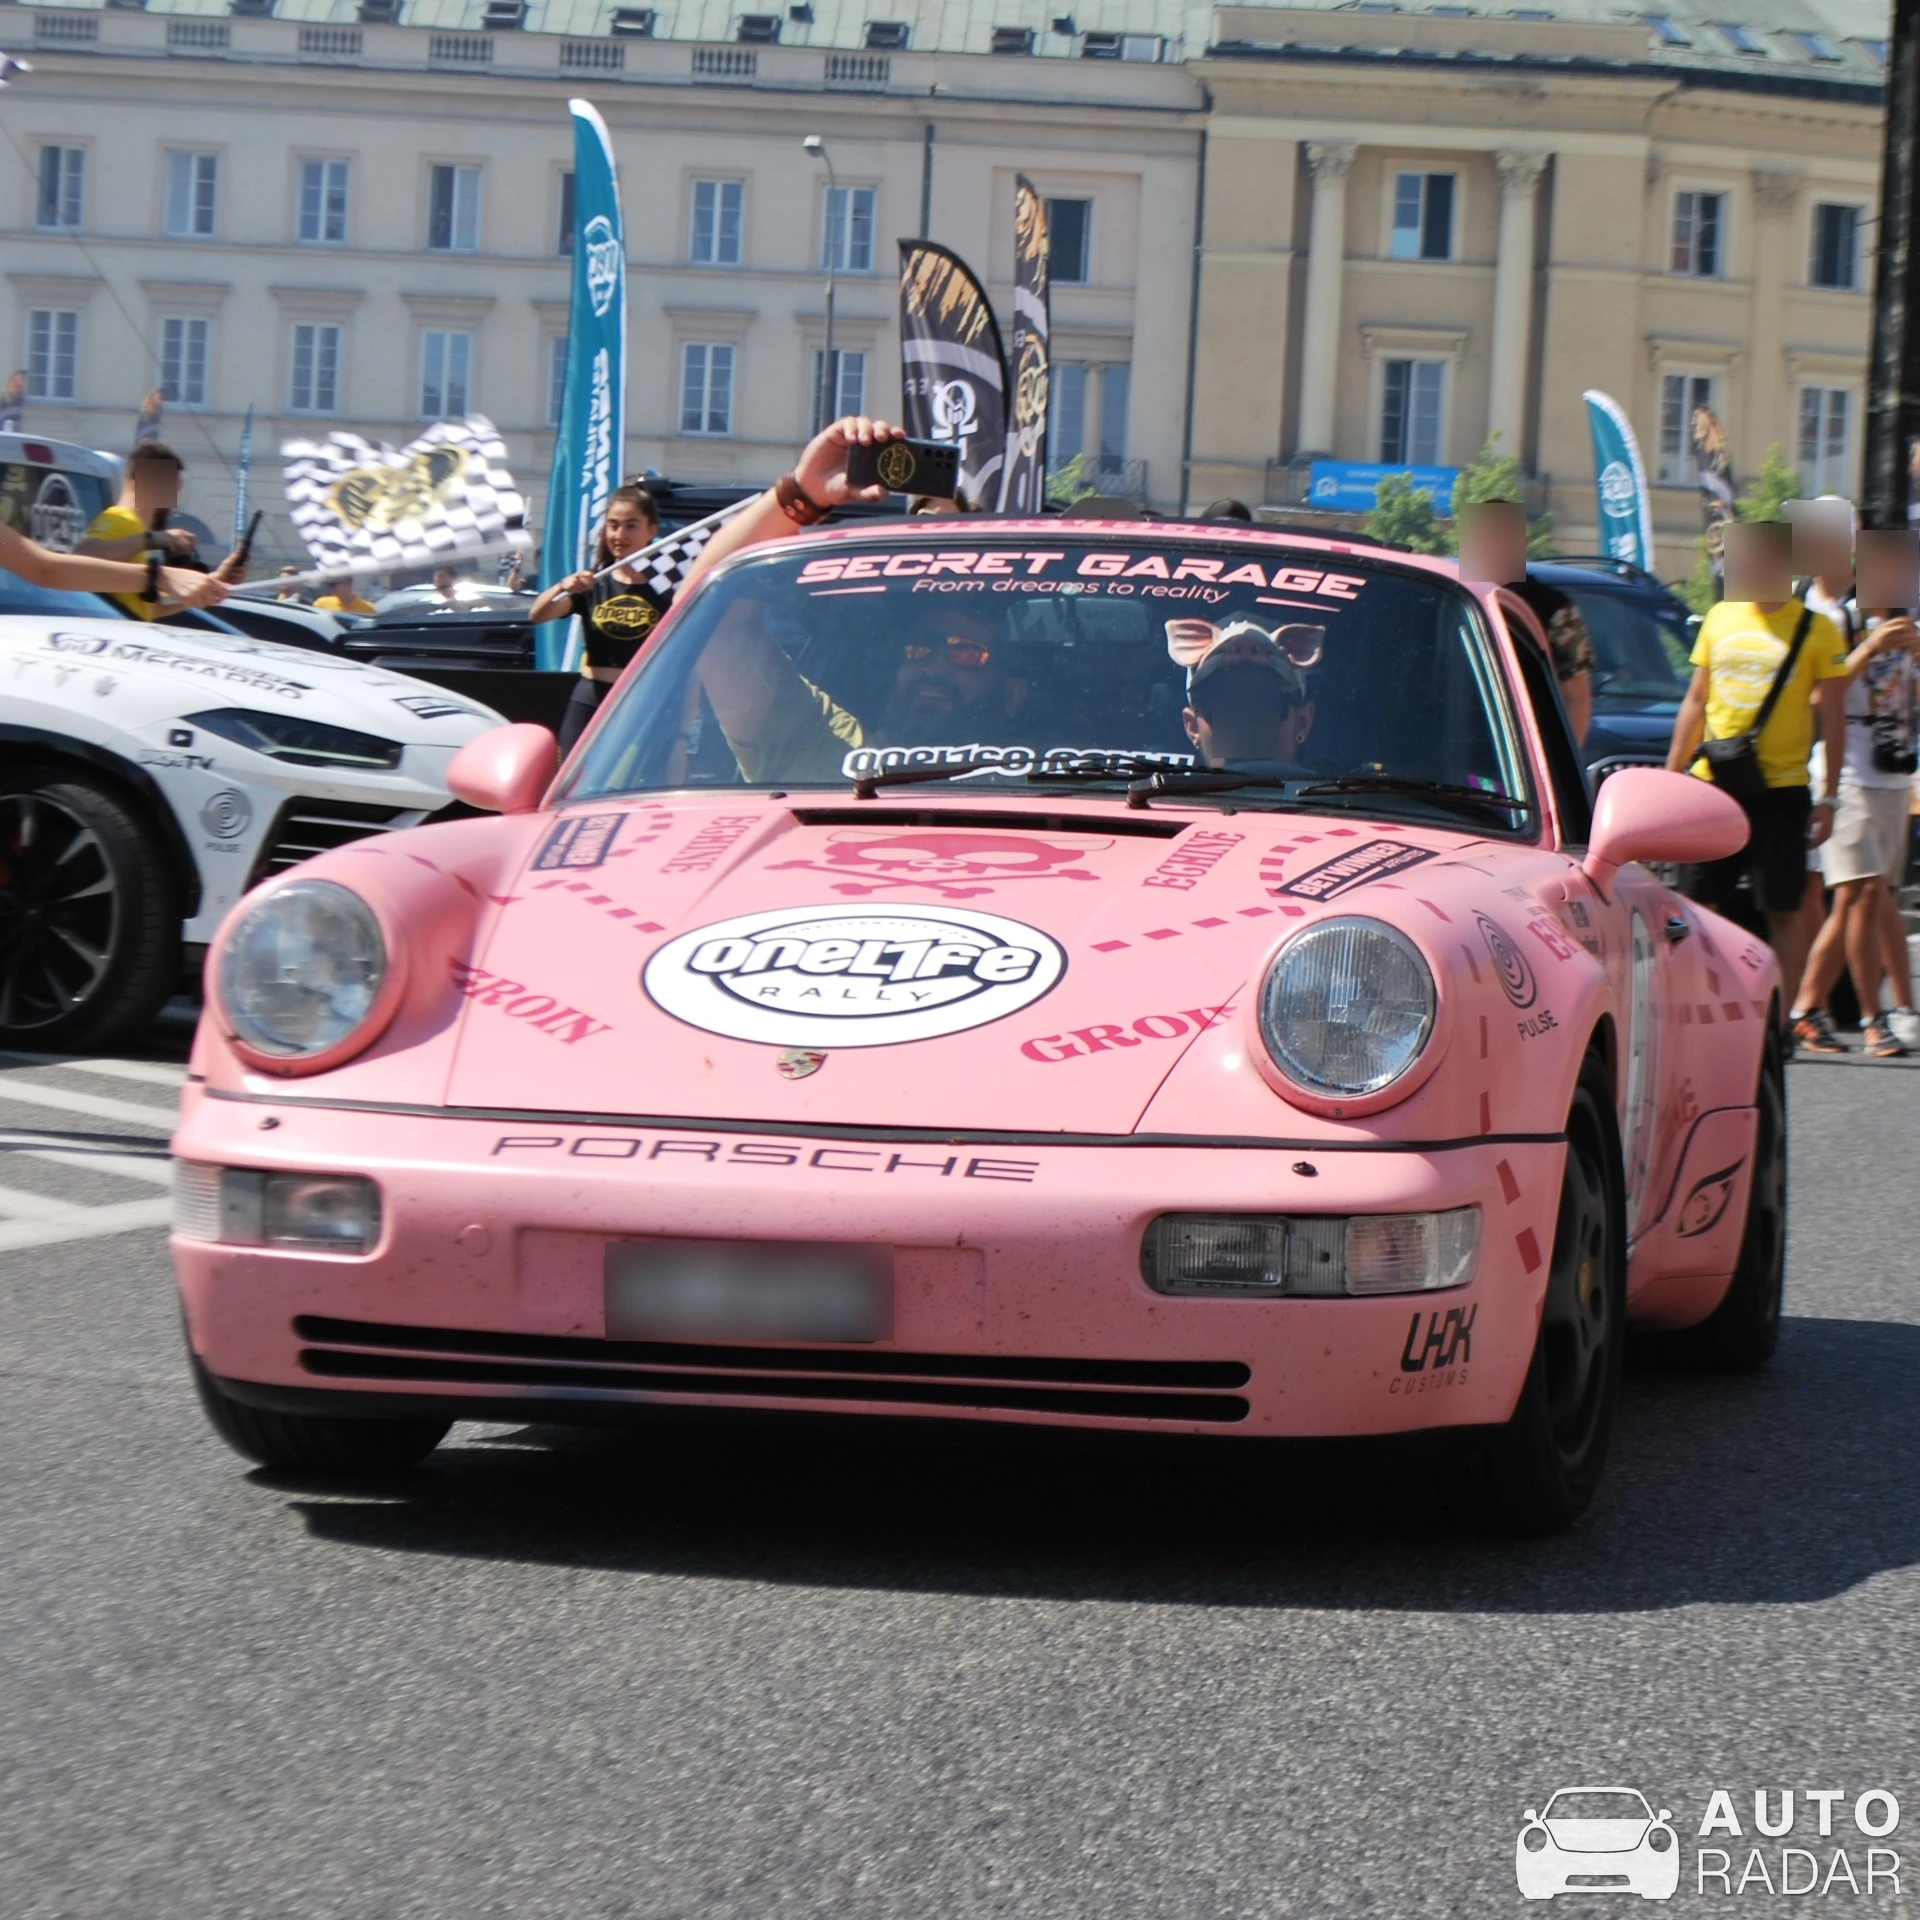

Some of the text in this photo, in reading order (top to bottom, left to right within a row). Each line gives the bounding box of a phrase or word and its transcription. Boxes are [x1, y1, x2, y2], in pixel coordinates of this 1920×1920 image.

[796, 552, 1367, 600] SECRET GARAGE
[912, 576, 1230, 604] From dreams to reality
[1289, 842, 1408, 897] BETWINNER
[758, 986, 932, 1002] RALLY
[1517, 1010, 1559, 1042] PULSE
[491, 1136, 1040, 1182] PORSCHE
